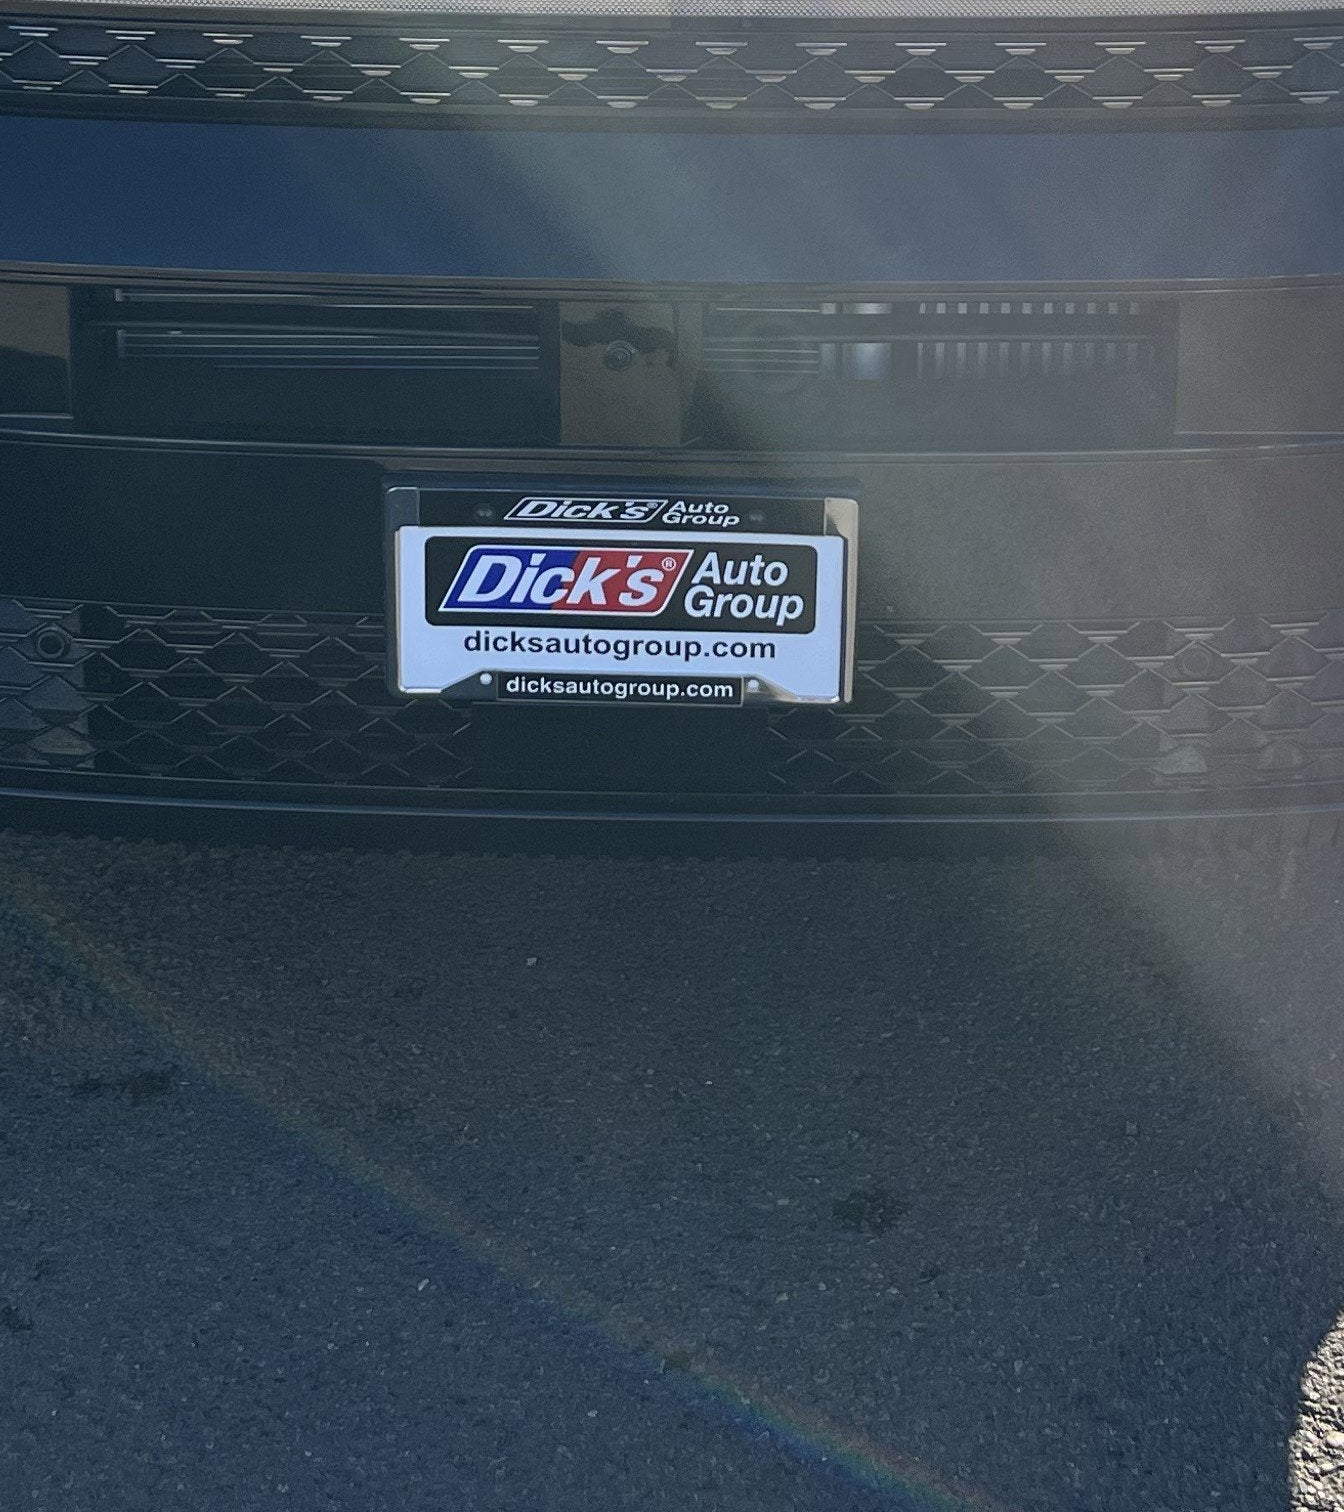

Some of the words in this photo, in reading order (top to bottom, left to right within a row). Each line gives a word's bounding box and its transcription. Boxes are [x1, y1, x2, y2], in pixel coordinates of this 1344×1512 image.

[662, 512, 740, 527] Group
[668, 500, 729, 514] Auto
[692, 552, 789, 587] Auto
[684, 586, 804, 625] Group
[464, 630, 777, 662] dicksautogroup.com
[505, 677, 734, 699] dicksautogroup.com
